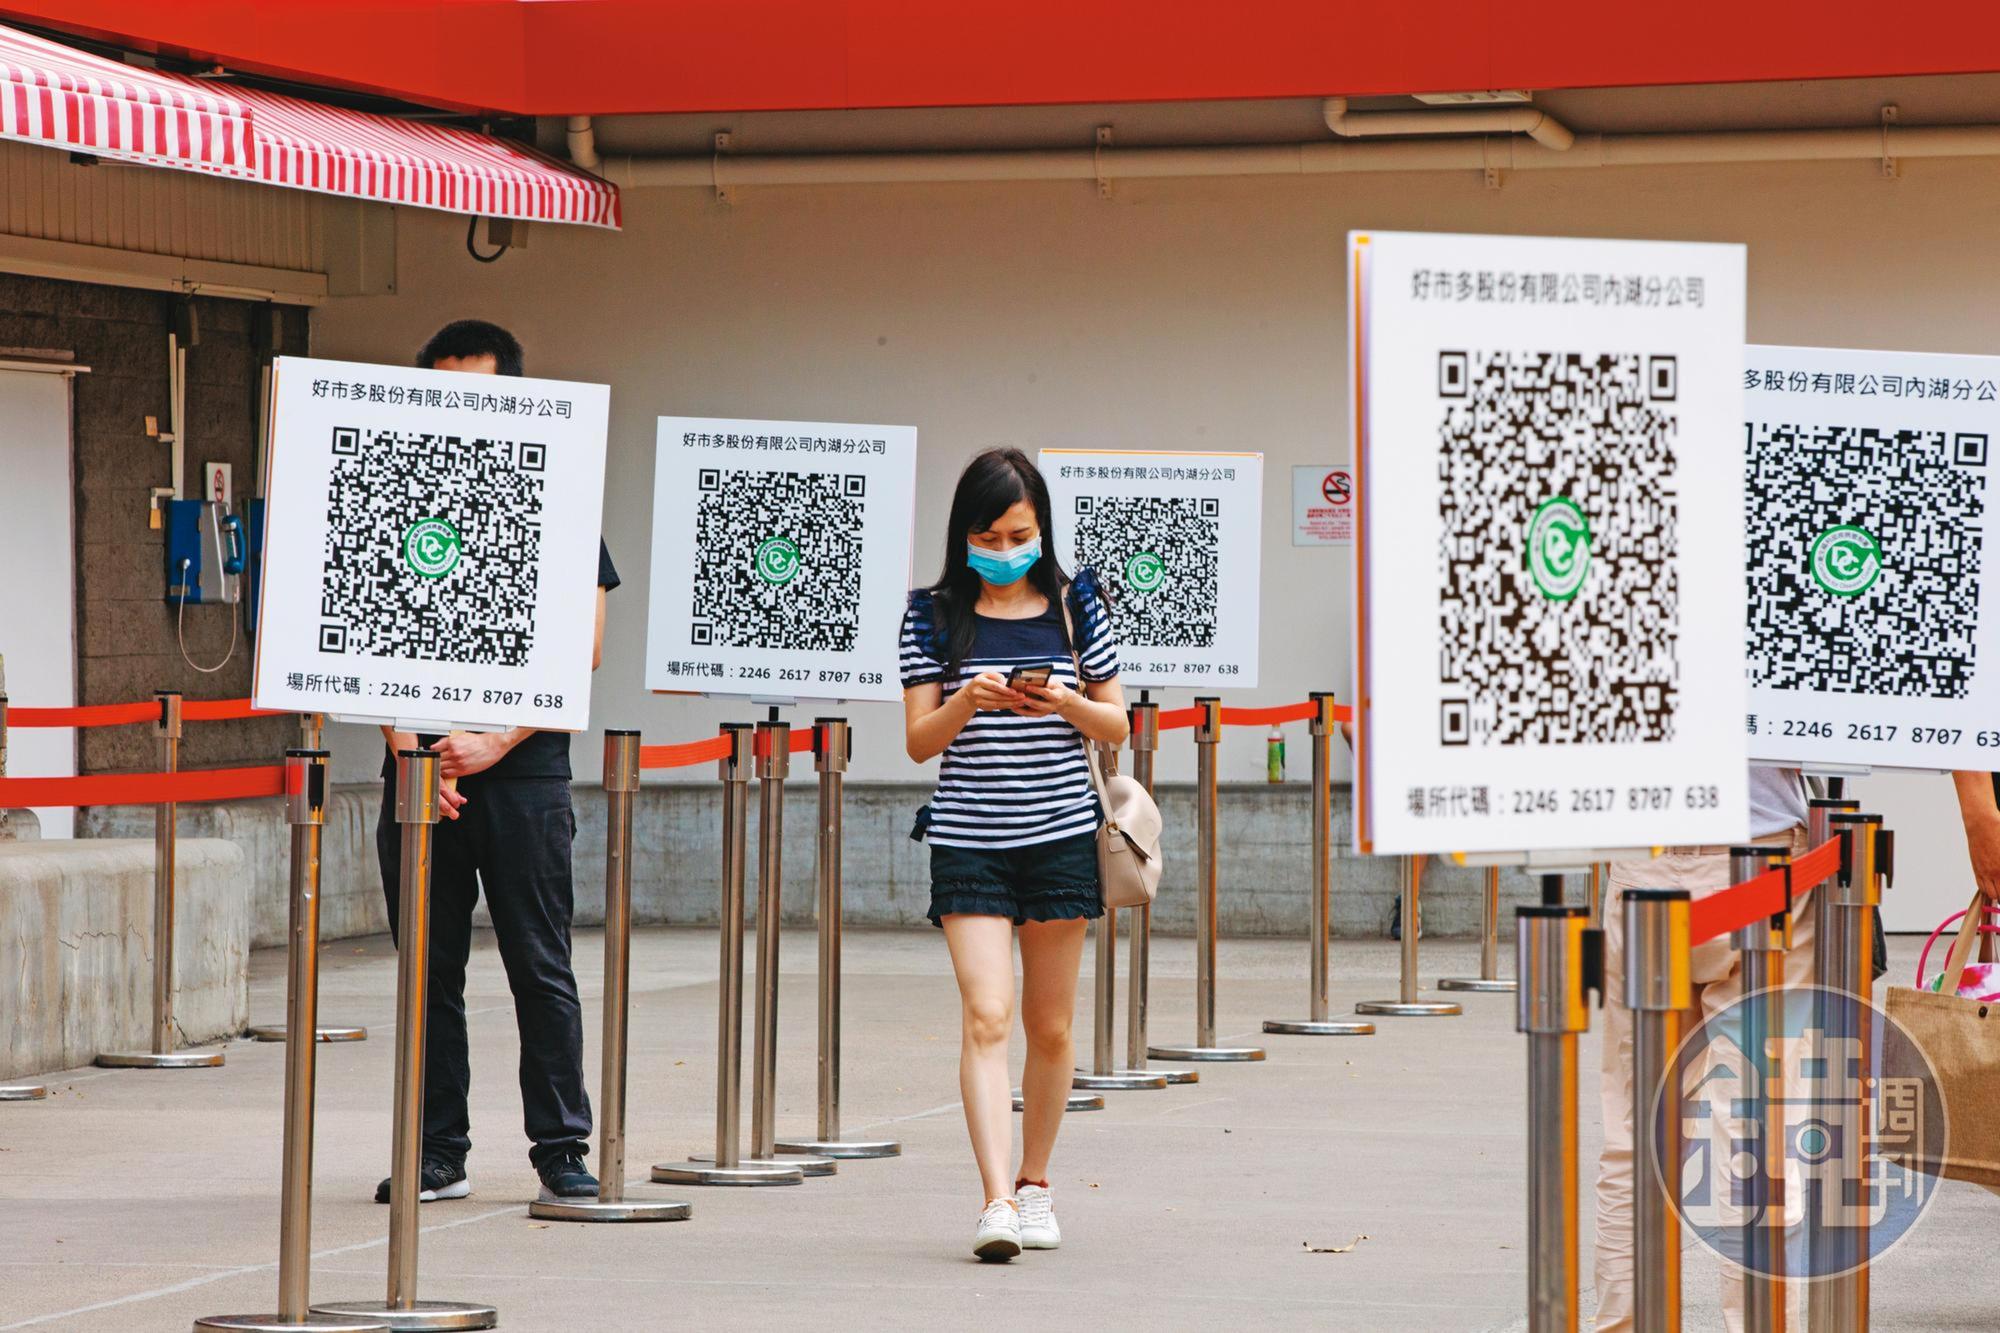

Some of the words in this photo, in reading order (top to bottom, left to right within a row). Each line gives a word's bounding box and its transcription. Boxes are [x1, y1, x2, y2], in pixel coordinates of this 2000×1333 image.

[311, 379, 573, 419] 好市多股份有限公司內湖分公司
[682, 432, 886, 455] 好市多股份有限公司內湖分公司
[739, 666, 771, 680] 2246
[779, 668, 811, 681] 2617
[818, 670, 851, 683] 8707
[858, 672, 883, 685] 638
[1119, 662, 1142, 673] 246
[1149, 662, 1177, 673] 2617
[1183, 663, 1211, 674] 8707
[1217, 664, 1239, 675] 638
[380, 682, 421, 699] 2246
[431, 686, 473, 702] 2617
[482, 689, 523, 706] 8707
[533, 693, 563, 709] 638
[1782, 719, 1833, 739] 2246
[1847, 723, 1898, 742] 2617
[1911, 727, 1963, 745] 8707
[1976, 730, 2000, 748] 63
[1513, 790, 1557, 814] 2246
[1571, 788, 1615, 812] 2617
[1629, 786, 1672, 811] 8707
[1685, 785, 1718, 809] 638
